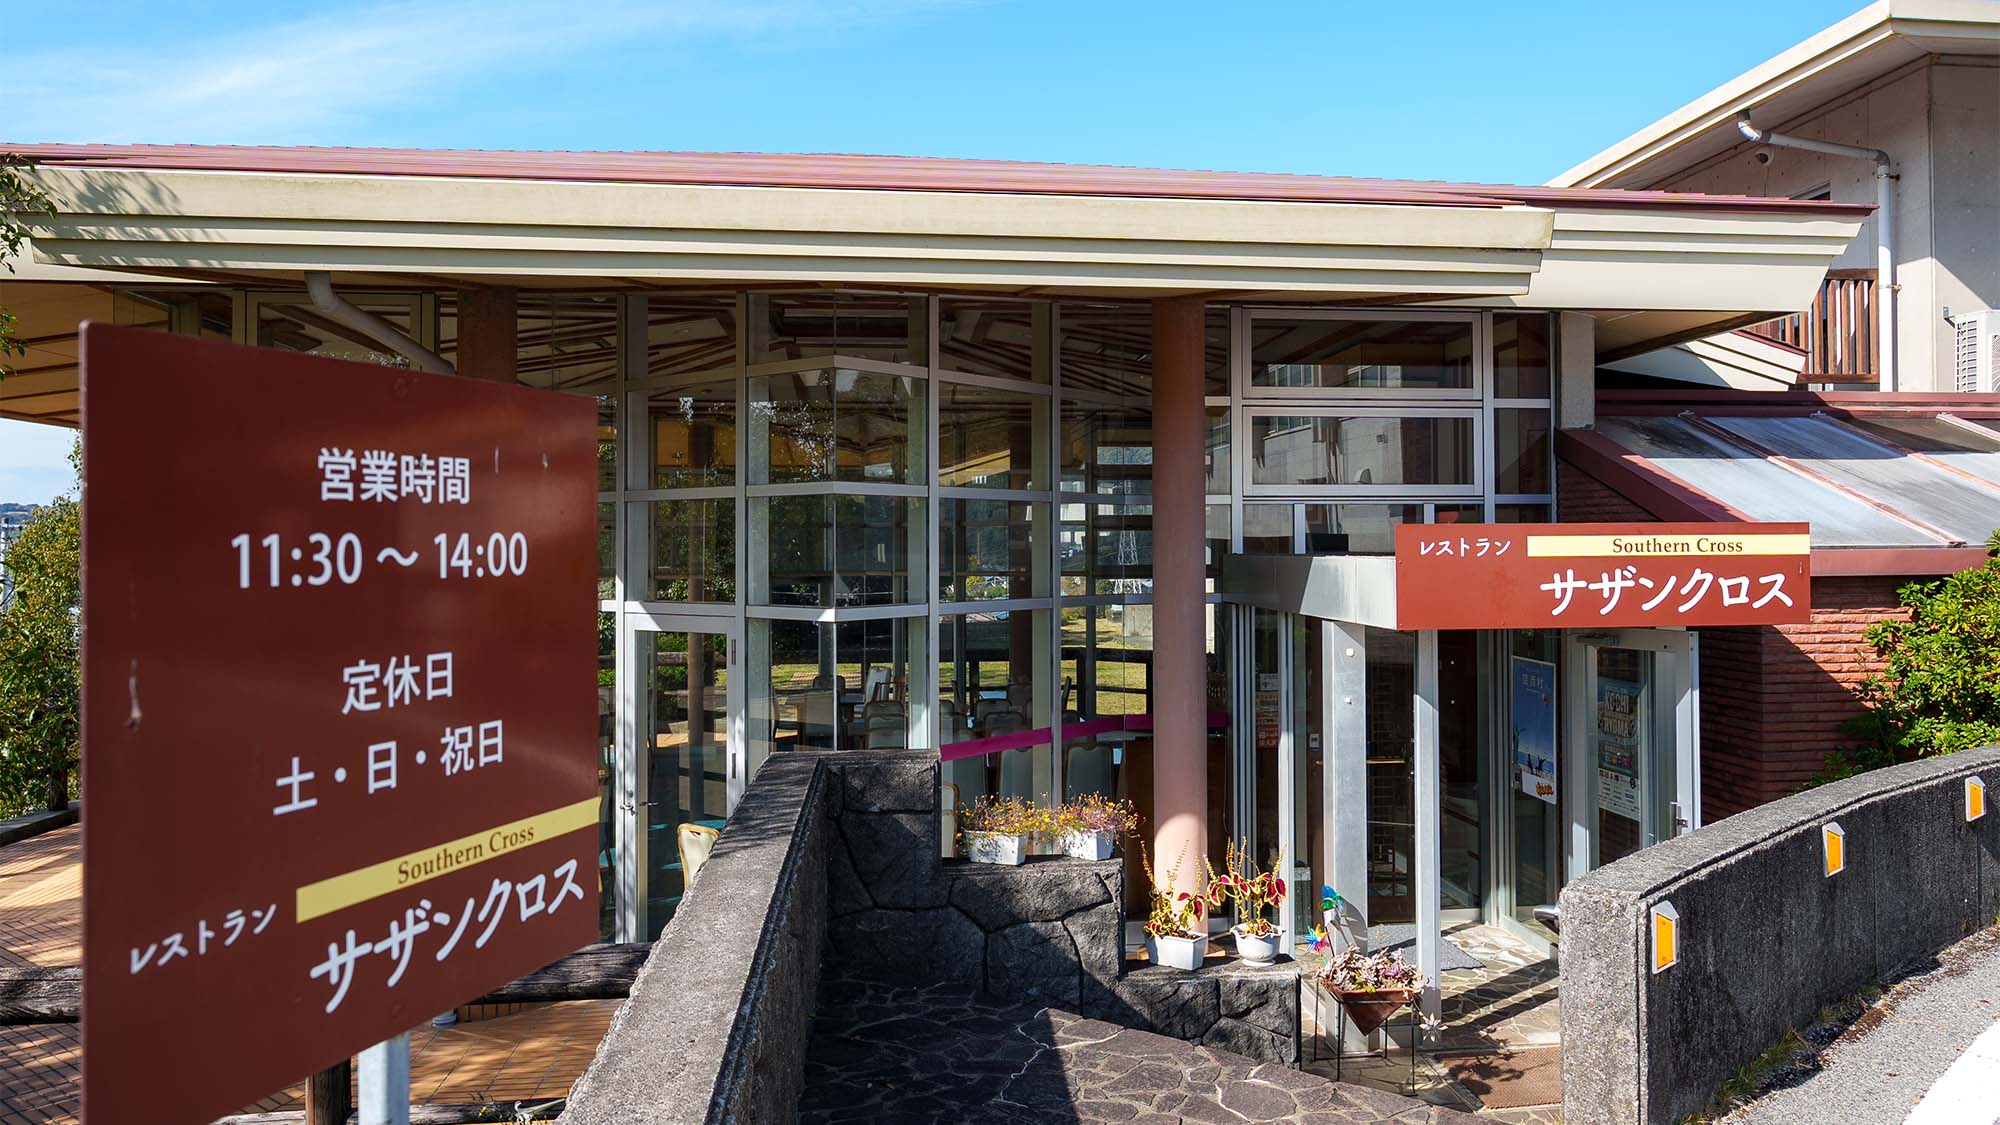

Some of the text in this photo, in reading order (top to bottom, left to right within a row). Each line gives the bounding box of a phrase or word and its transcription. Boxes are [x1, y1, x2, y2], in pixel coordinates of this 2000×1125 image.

[317, 447, 471, 505] 営業時間
[231, 532, 363, 588] 11:30
[434, 531, 528, 579] 14:00
[1419, 536, 1511, 558] レストラン
[1612, 537, 1743, 553] Southern Cross
[1539, 565, 1794, 616] サザンクロス
[341, 651, 455, 715] 定休日
[273, 719, 506, 816] 土・日・祝日
[397, 826, 535, 884] Southern Cross
[129, 902, 278, 975] レストラン
[309, 857, 584, 1014] サザンクロス
